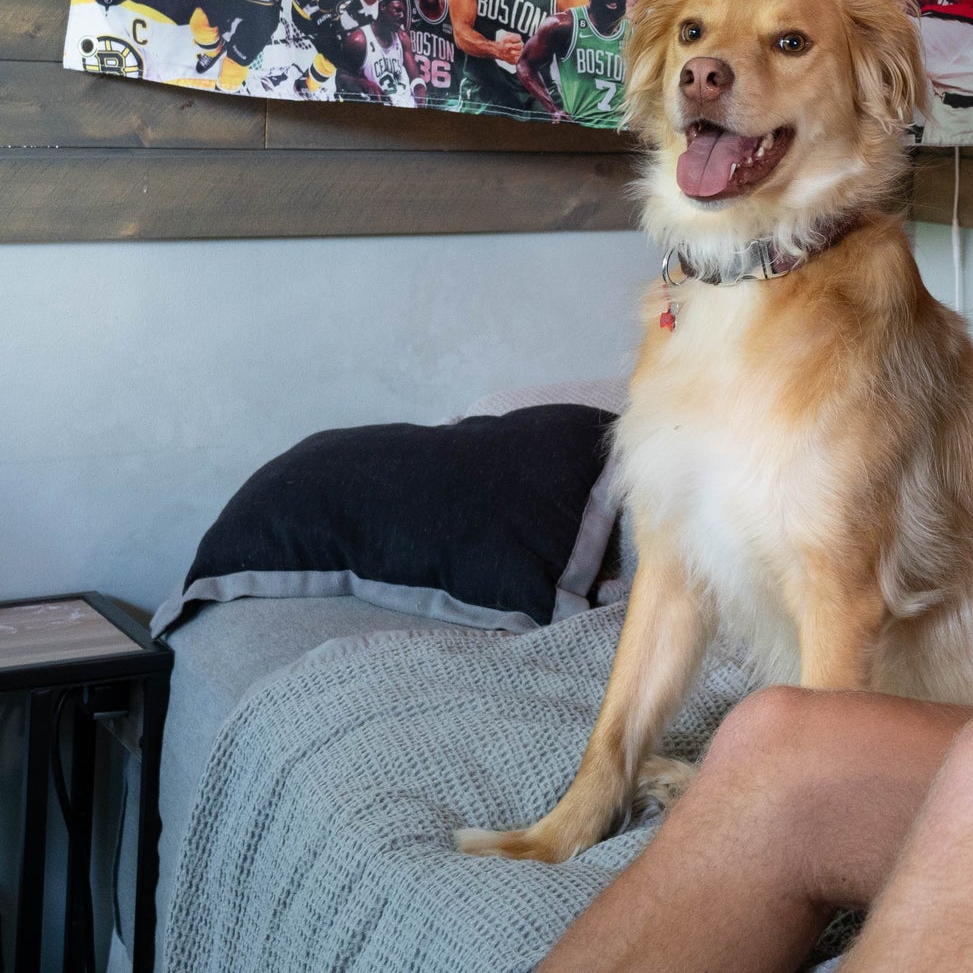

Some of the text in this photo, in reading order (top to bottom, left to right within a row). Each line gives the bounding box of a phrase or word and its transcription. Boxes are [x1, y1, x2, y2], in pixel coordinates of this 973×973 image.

[132, 19, 147, 45] C
[411, 29, 456, 63] BOSTON
[414, 54, 452, 89] 36
[595, 79, 617, 112] 7
